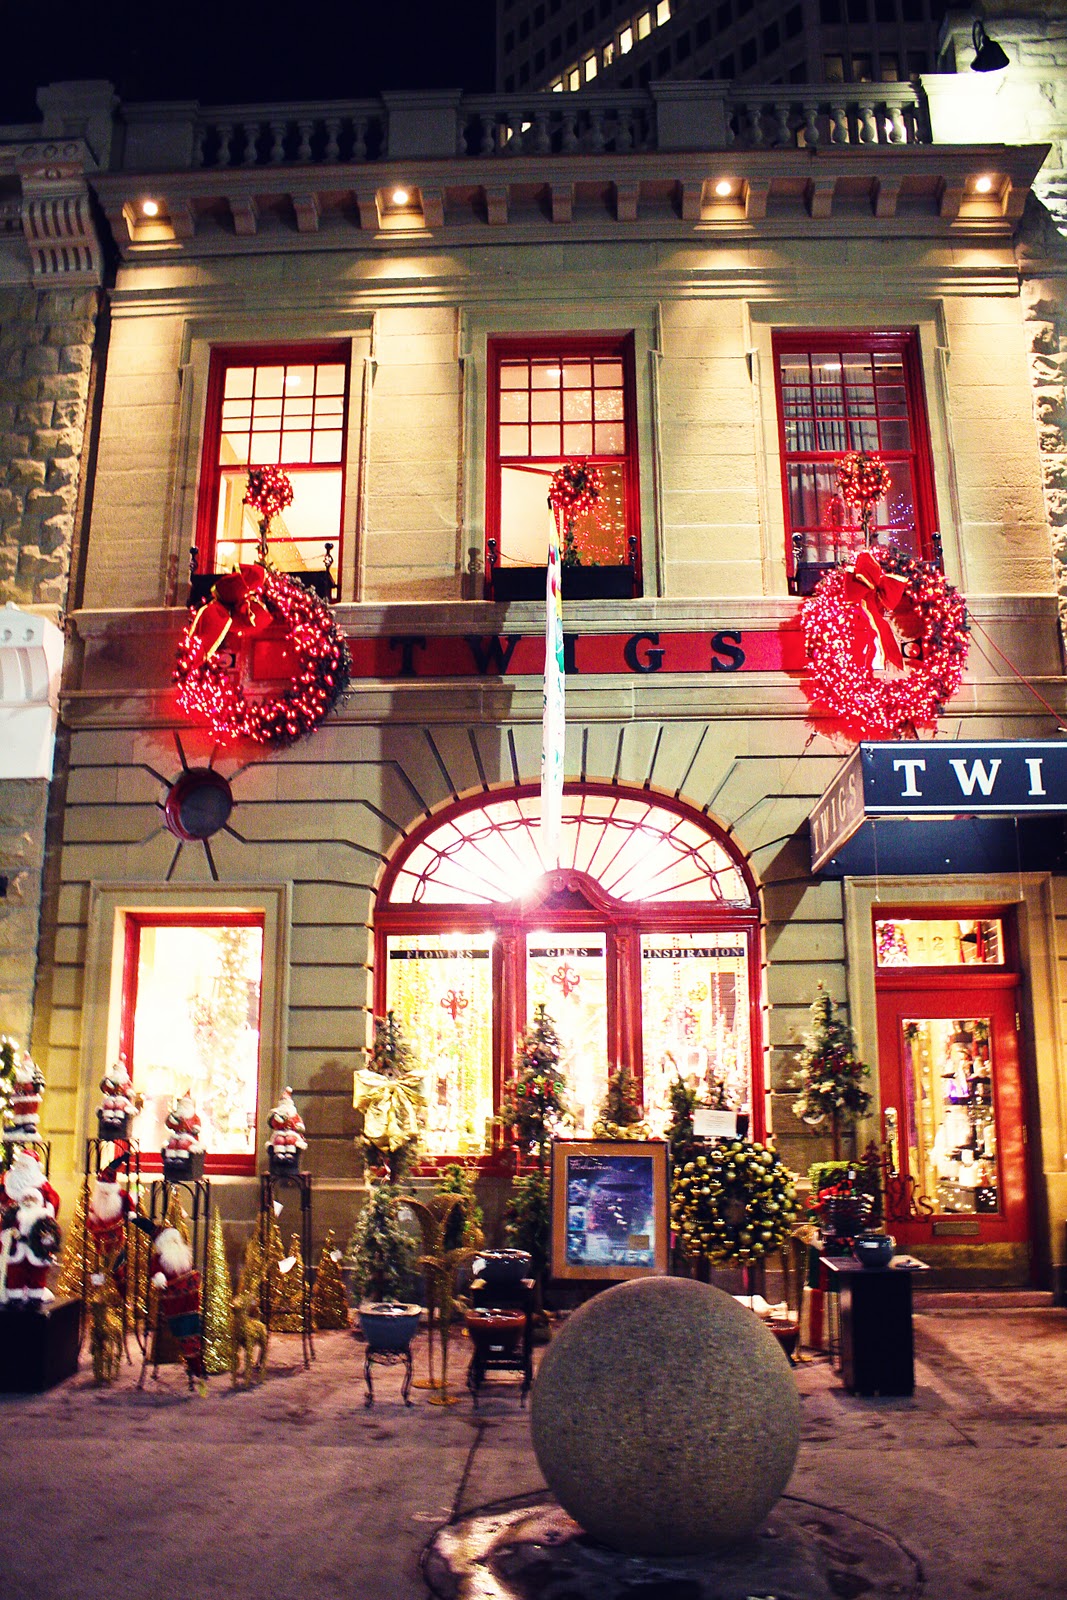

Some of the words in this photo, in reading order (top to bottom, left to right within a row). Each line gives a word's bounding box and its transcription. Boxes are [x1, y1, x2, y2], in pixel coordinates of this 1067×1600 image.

[390, 631, 746, 675] TWIGS
[812, 773, 858, 854] TWIGS
[406, 949, 474, 960] FLOWERS
[545, 948, 589, 958] GIFTS
[646, 948, 741, 959] INSPIRATION
